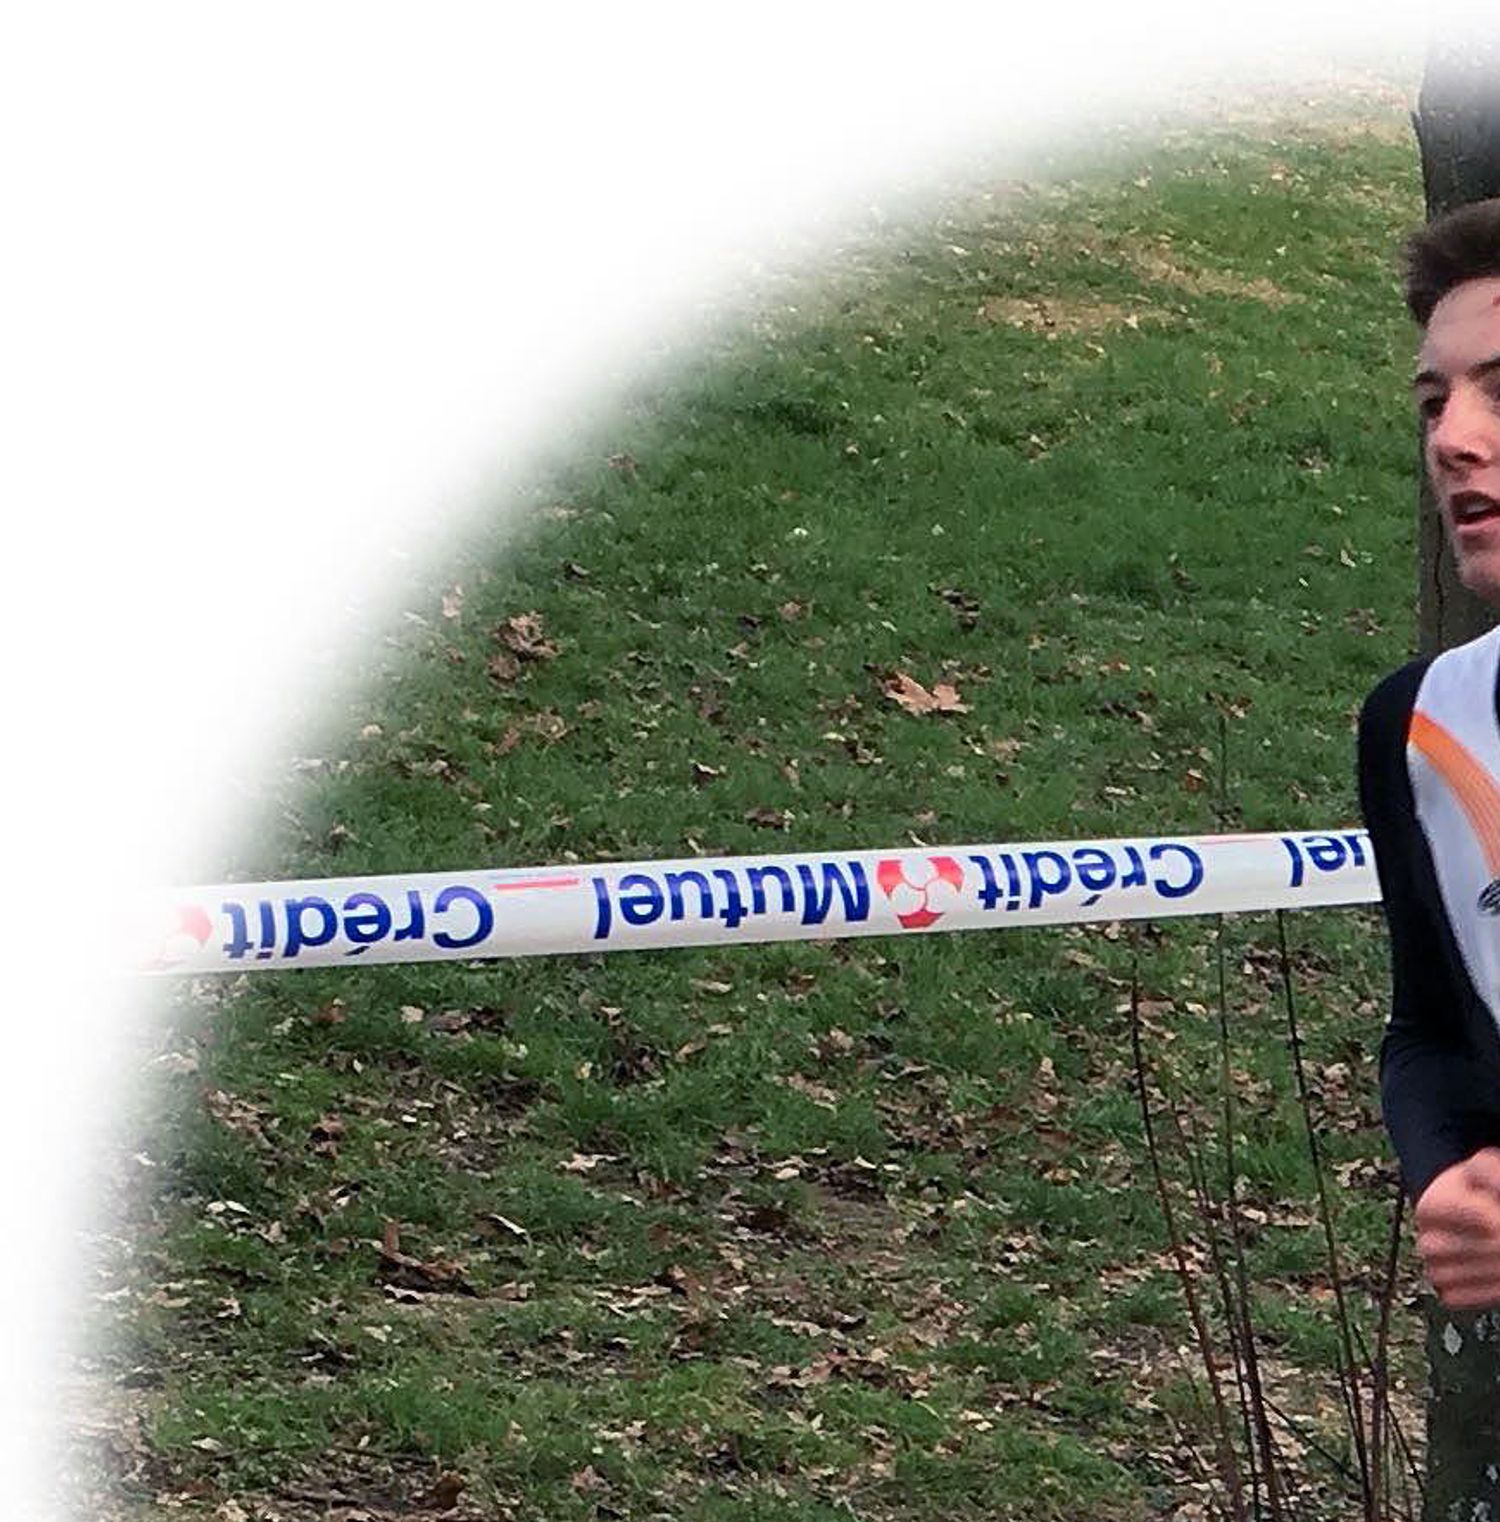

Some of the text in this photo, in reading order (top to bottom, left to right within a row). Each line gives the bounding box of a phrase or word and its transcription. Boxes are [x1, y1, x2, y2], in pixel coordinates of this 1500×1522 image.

[593, 861, 870, 939] Mutuel
[971, 843, 1204, 912] Crédit
[222, 886, 495, 957] Crédit
